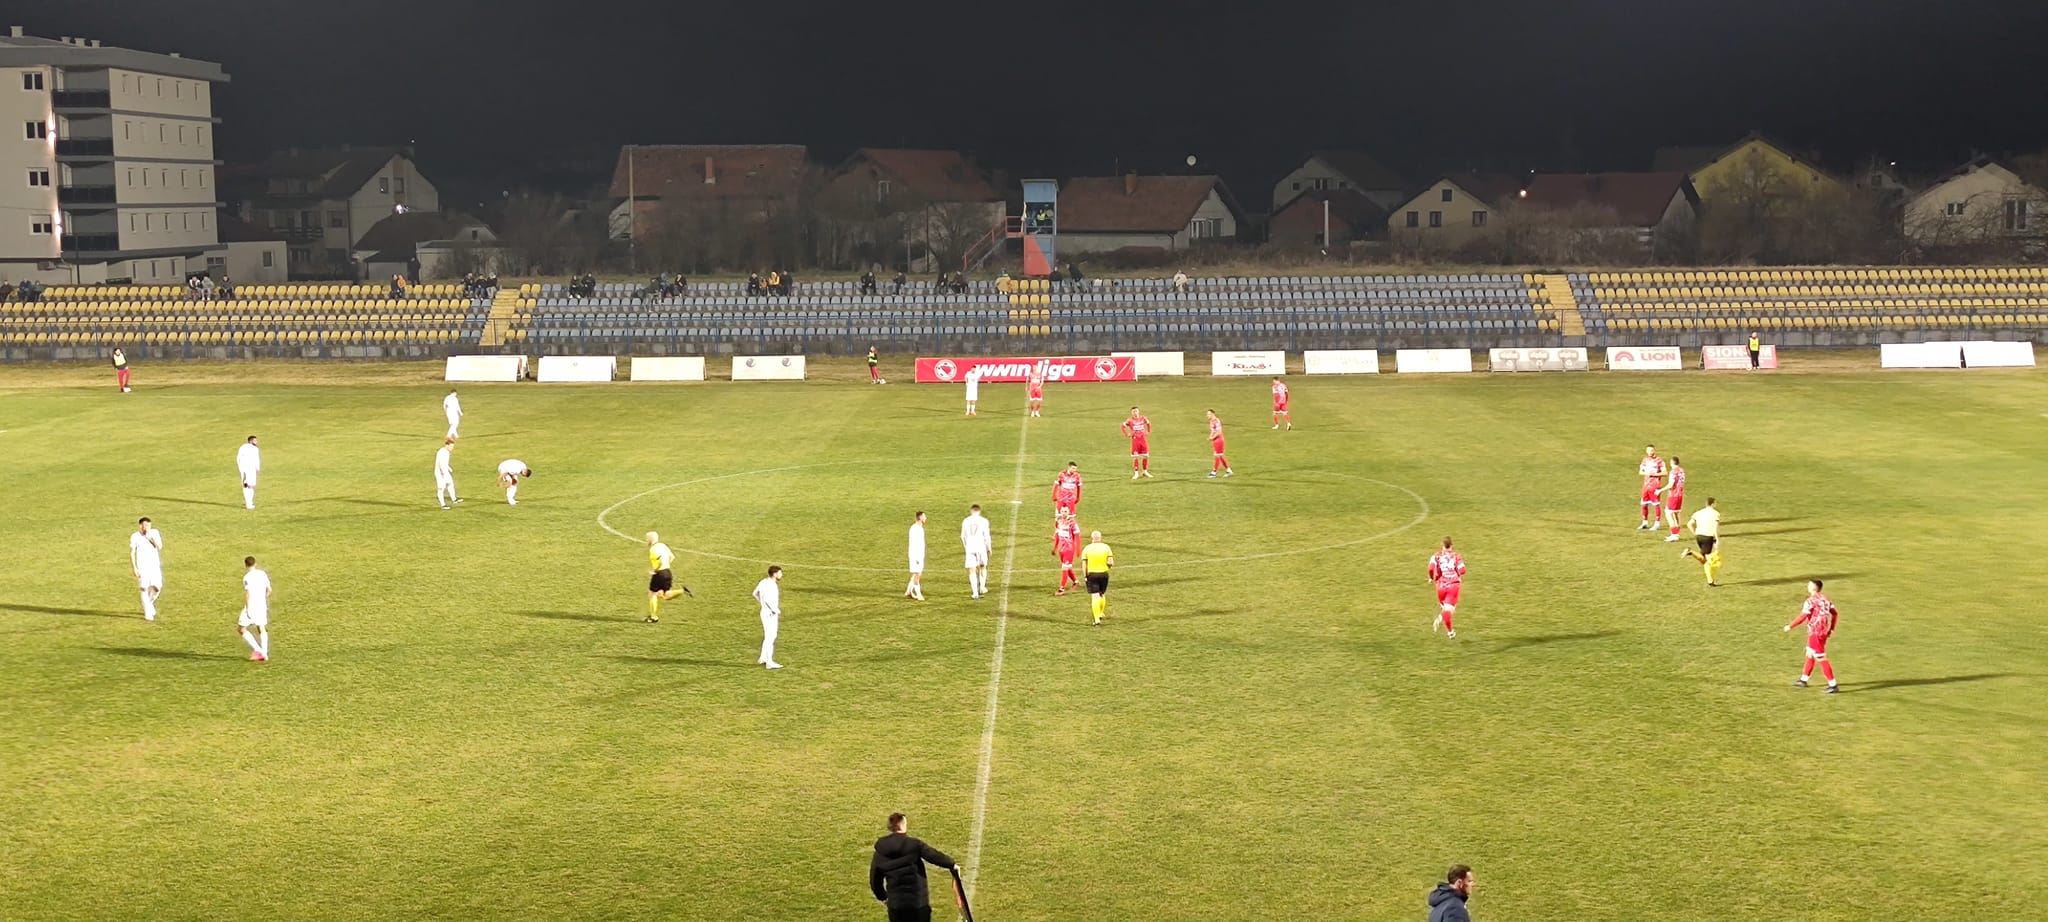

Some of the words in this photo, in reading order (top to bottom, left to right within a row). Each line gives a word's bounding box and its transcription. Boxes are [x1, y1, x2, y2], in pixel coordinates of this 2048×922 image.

[1640, 353, 1676, 361] LION
[1037, 358, 1077, 380] liga
[1440, 554, 1456, 570] 24
